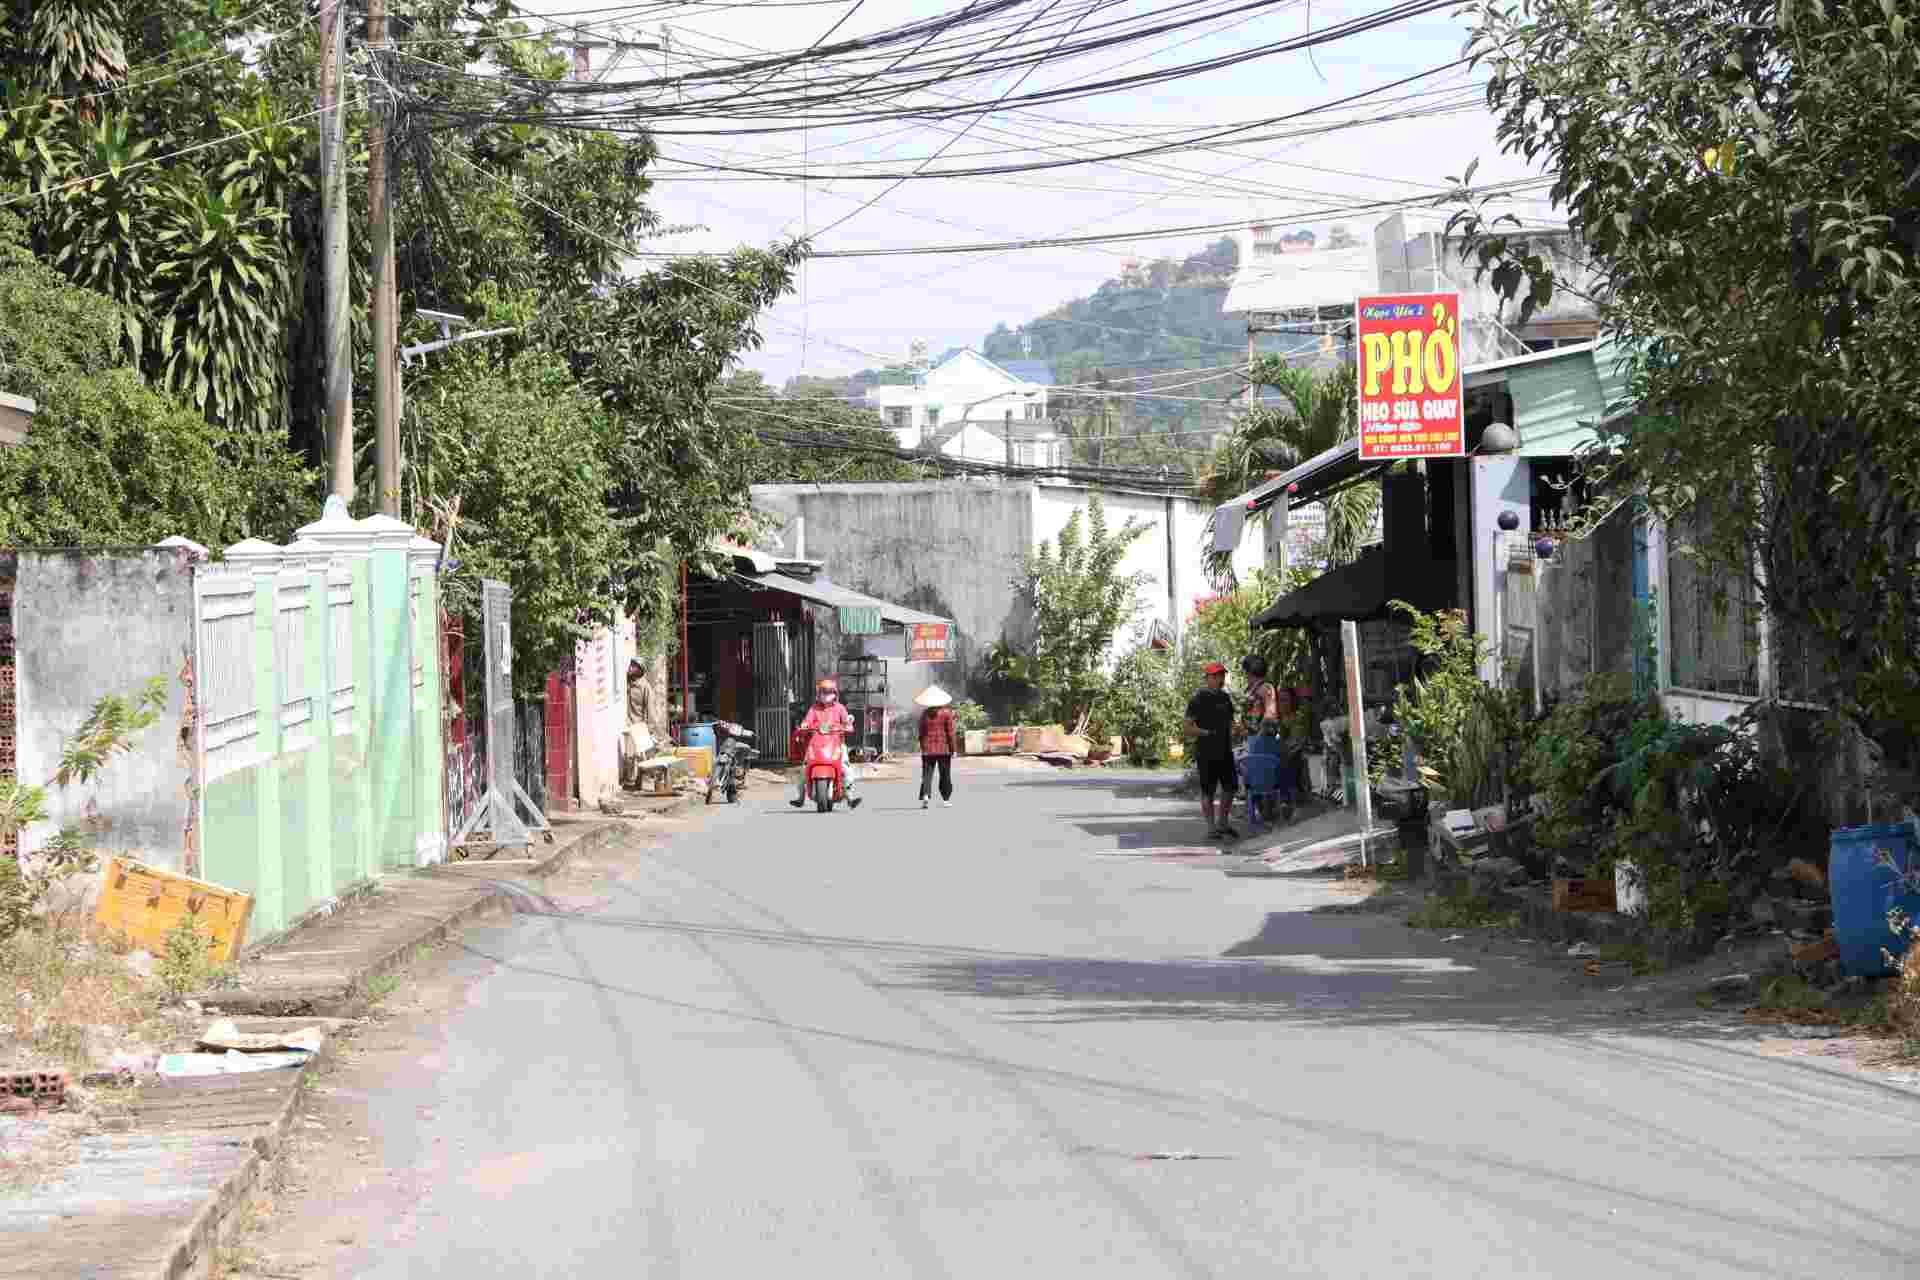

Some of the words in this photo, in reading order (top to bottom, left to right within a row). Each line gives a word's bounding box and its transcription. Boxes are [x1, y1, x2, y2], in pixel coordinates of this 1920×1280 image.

[1362, 302, 1457, 395] PHỞ
[1362, 402, 1389, 421] HEO
[1423, 399, 1458, 420] QUAY
